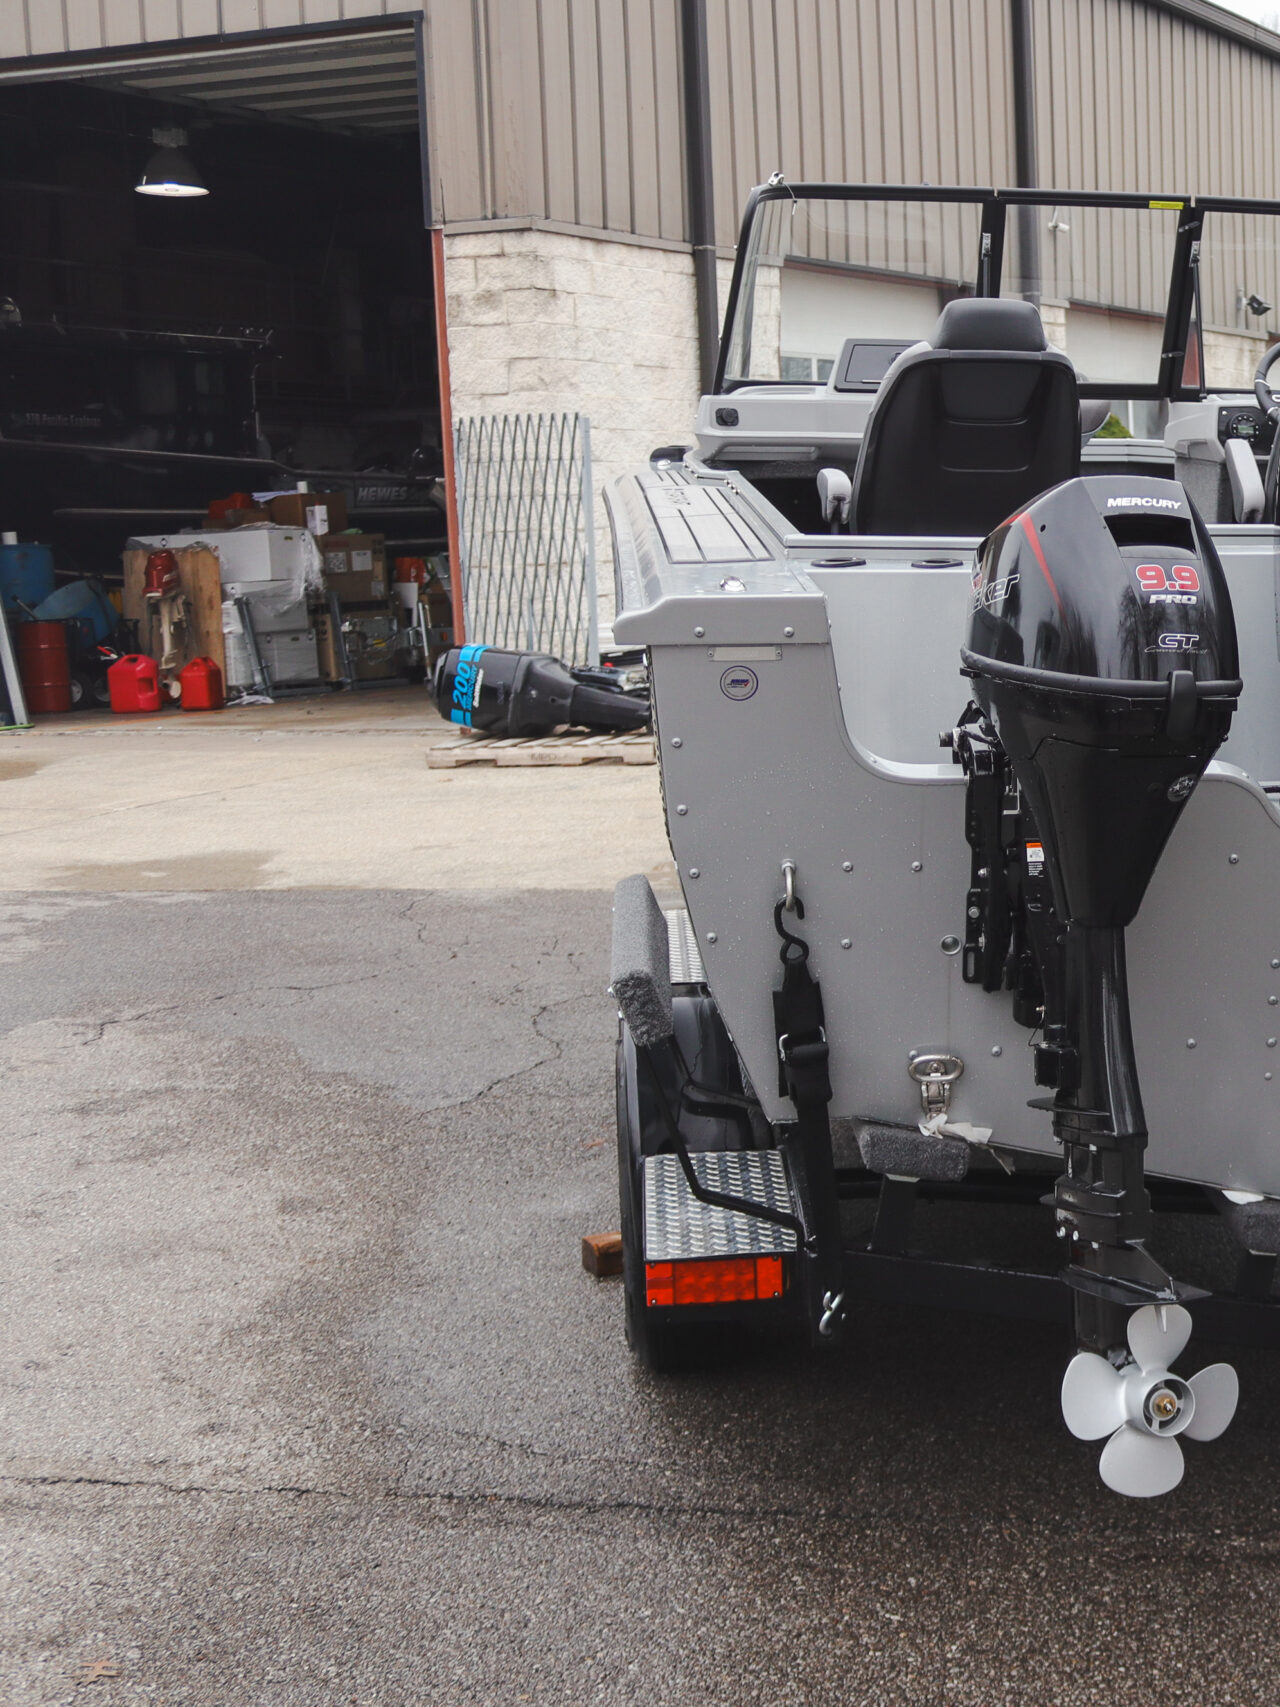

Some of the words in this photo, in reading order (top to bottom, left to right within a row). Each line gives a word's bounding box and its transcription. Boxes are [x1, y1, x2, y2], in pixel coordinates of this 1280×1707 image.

[1107, 497, 1183, 509] MERCURY
[1135, 564, 1200, 591] 9.9
[1149, 593, 1198, 605] PRO
[1158, 633, 1200, 648] CT
[452, 661, 471, 709] 200
